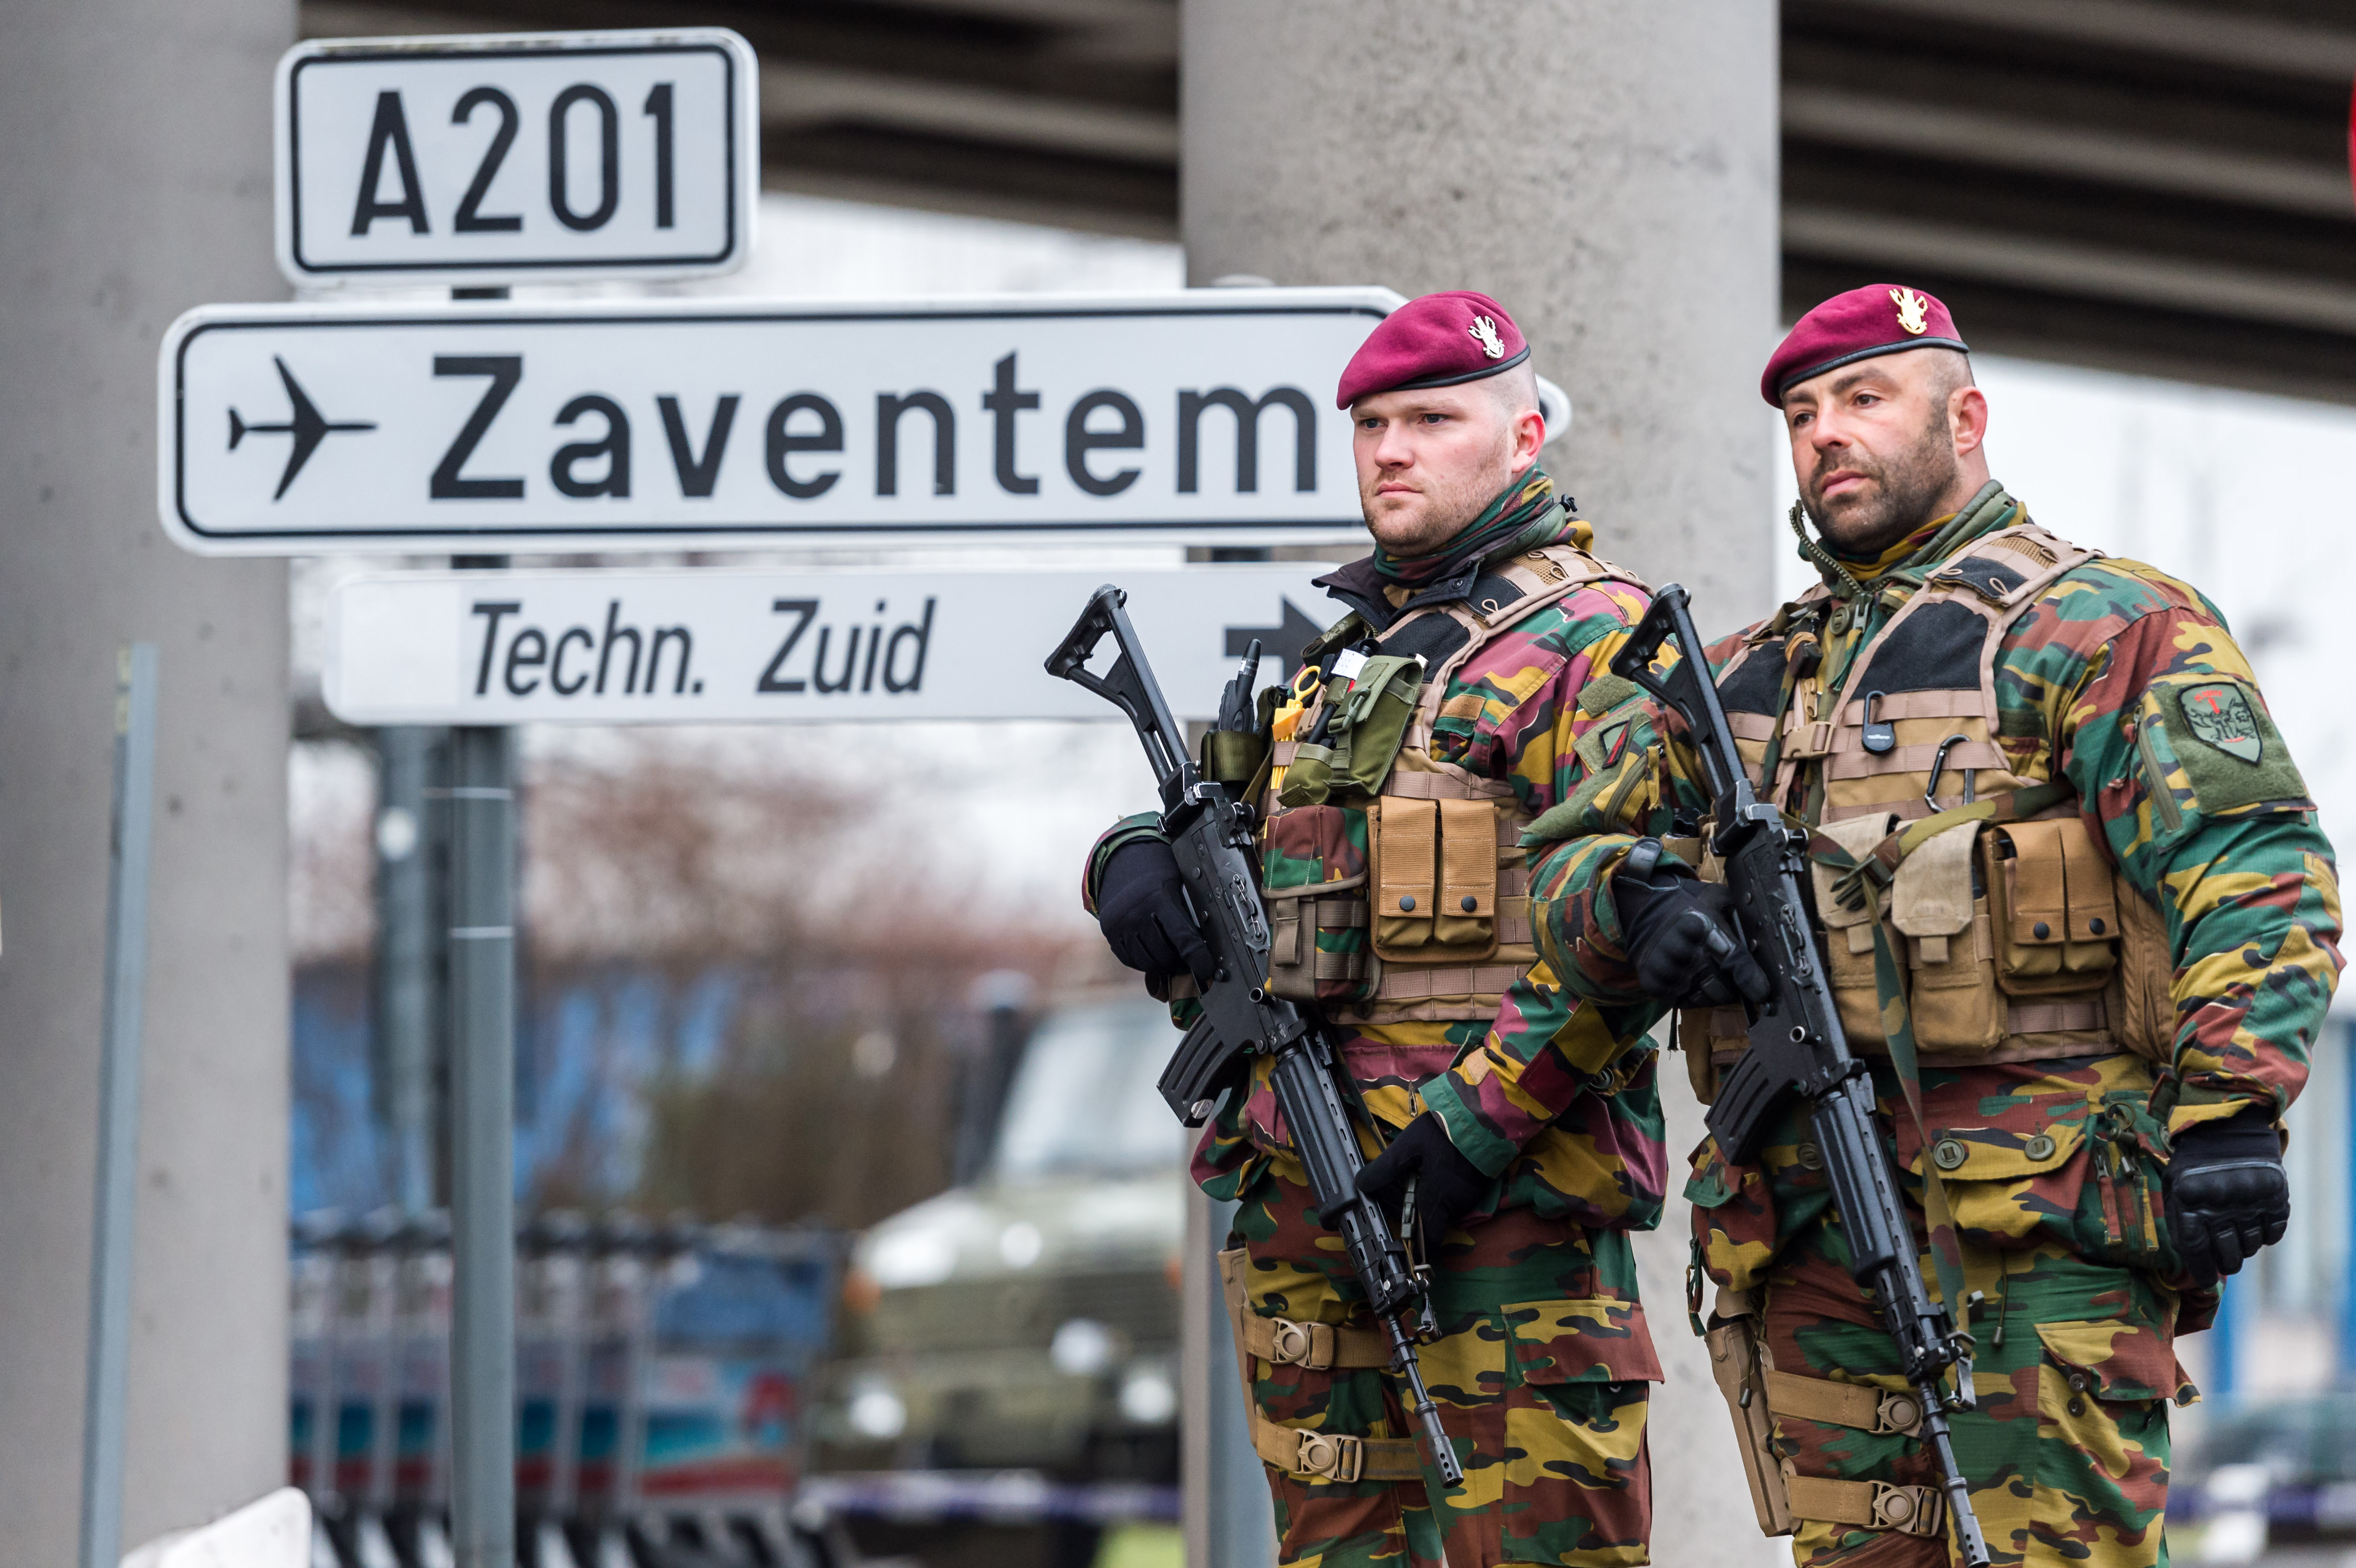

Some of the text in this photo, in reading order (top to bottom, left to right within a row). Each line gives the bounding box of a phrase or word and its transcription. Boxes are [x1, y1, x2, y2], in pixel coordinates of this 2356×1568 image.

[350, 82, 675, 237] A201
[429, 353, 1318, 500] Zaventem
[471, 598, 936, 696] Techn. Zuid
